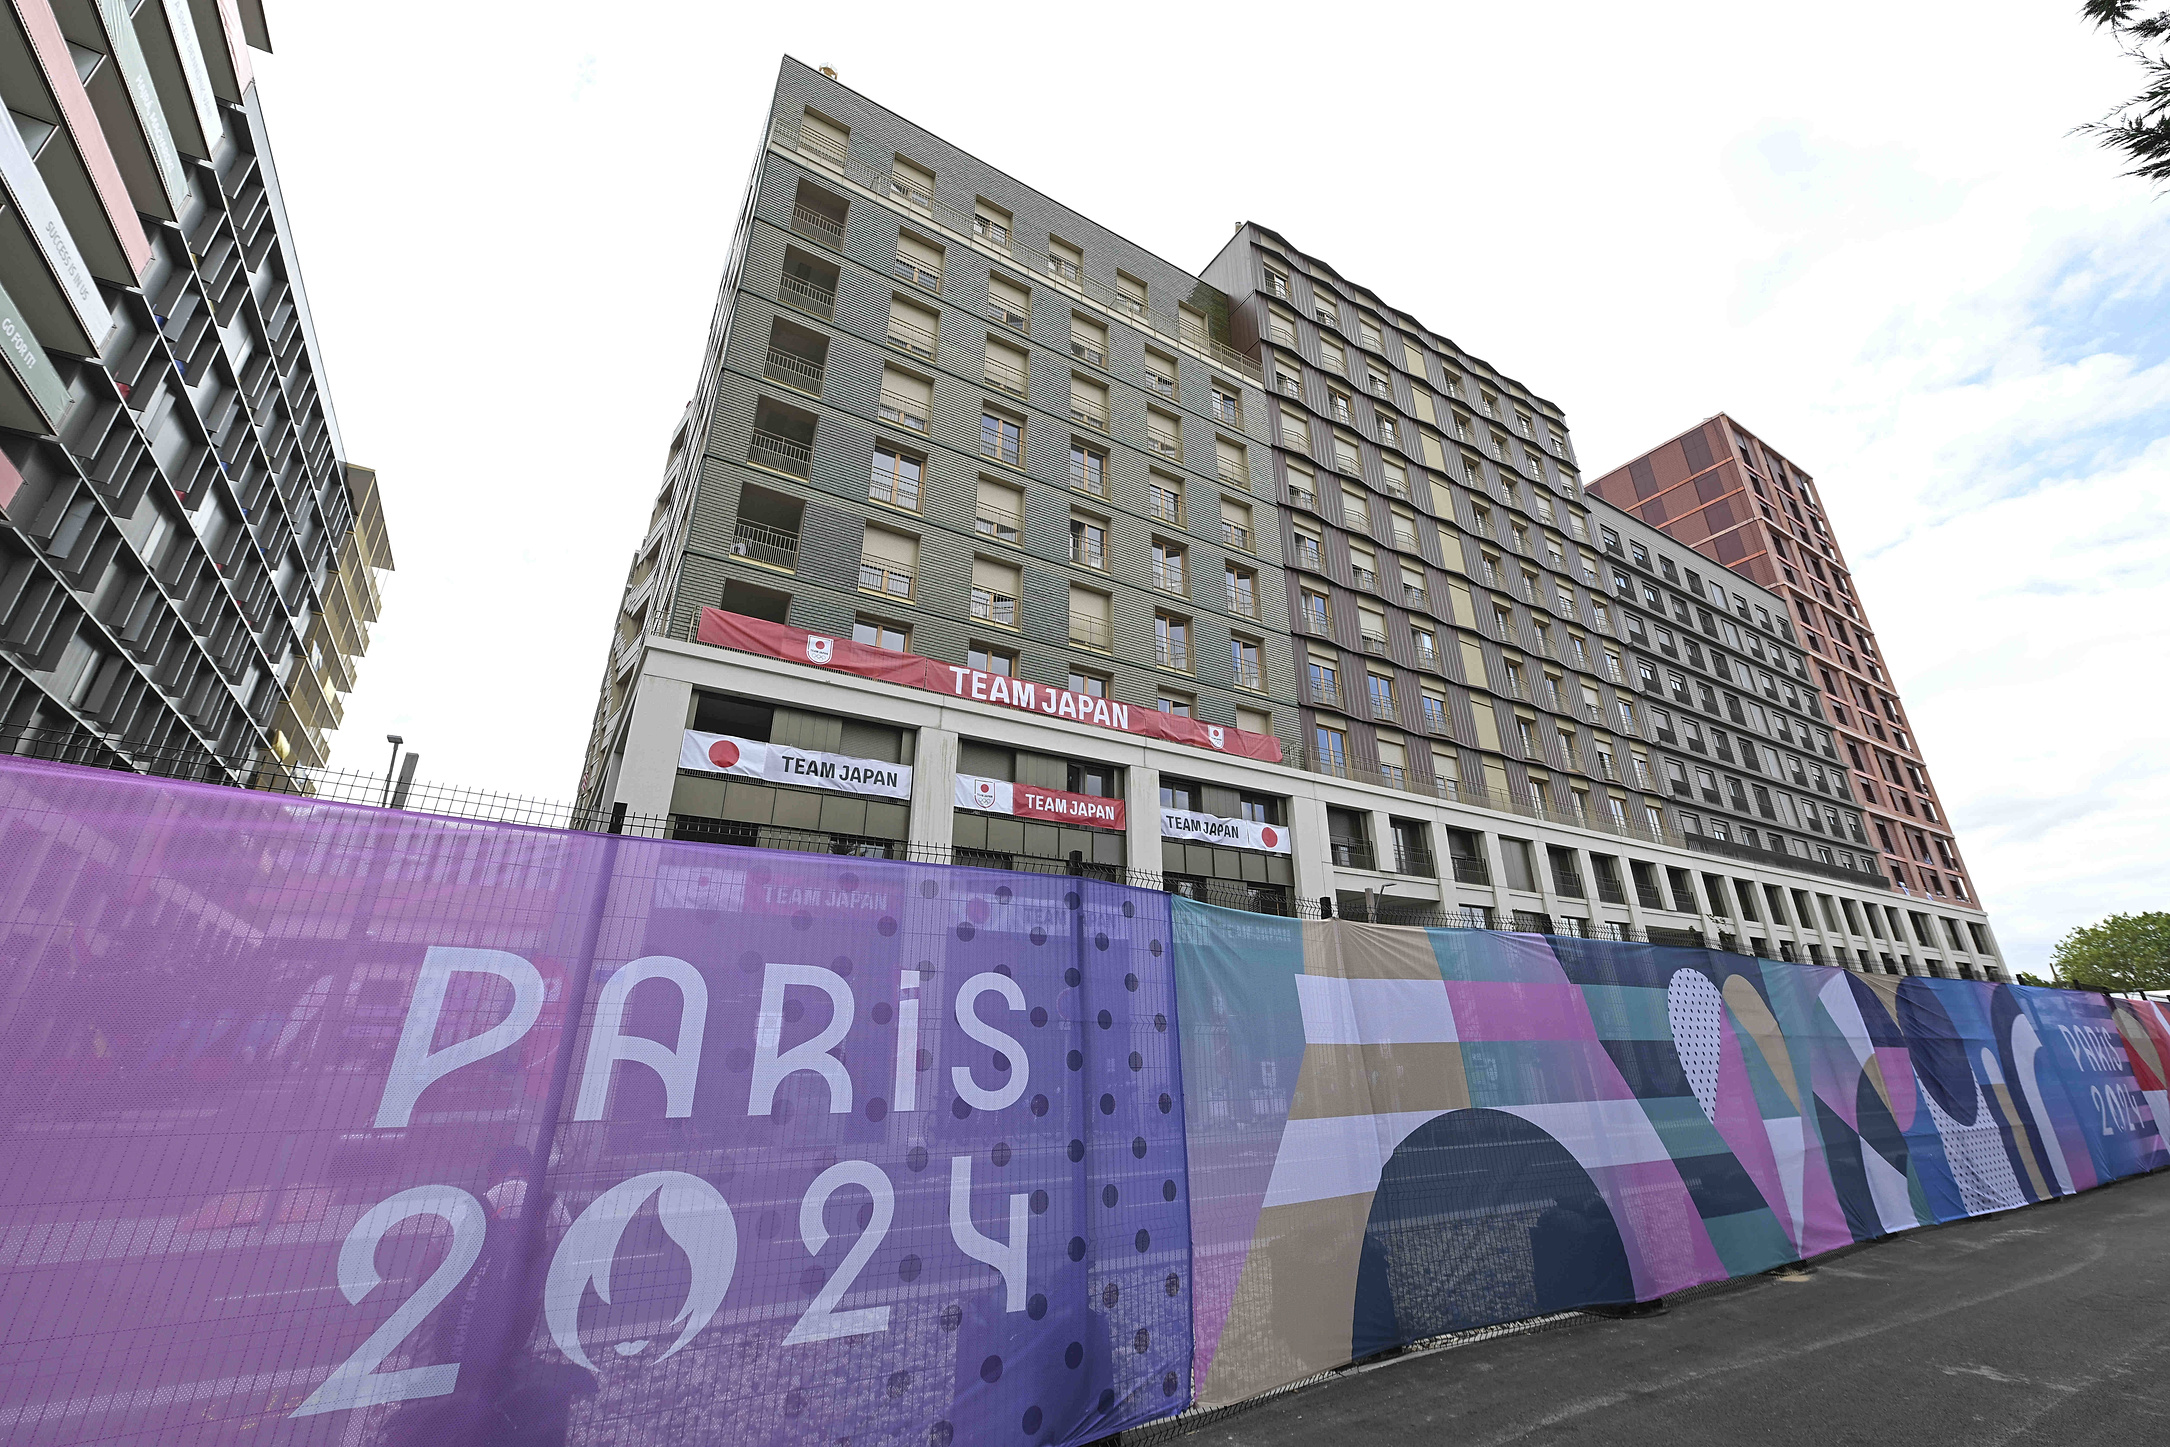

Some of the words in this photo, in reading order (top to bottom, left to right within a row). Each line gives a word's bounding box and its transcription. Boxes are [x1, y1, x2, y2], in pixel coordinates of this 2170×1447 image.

[45, 221, 72, 266] SUCCESS
[68, 263, 78, 276] IS
[72, 273, 83, 288] IN
[78, 285, 90, 301] US
[1, 317, 16, 336] GO
[10, 332, 30, 358] FOR
[23, 351, 37, 369] IT!
[949, 666, 1035, 709] TEAM
[1042, 687, 1129, 729] JAPAN
[782, 755, 835, 778] TEAM
[839, 765, 898, 787] JAPAN
[1025, 793, 1067, 814] TEAM
[1069, 801, 1115, 820] JAPAN
[1165, 815, 1202, 832] TEAM
[1203, 821, 1239, 838] JAPAN
[763, 884, 821, 906] TEAM
[824, 889, 888, 911] JAPAN
[2090, 1083, 2145, 1136] 2024
[288, 1156, 1029, 1419] 2024
